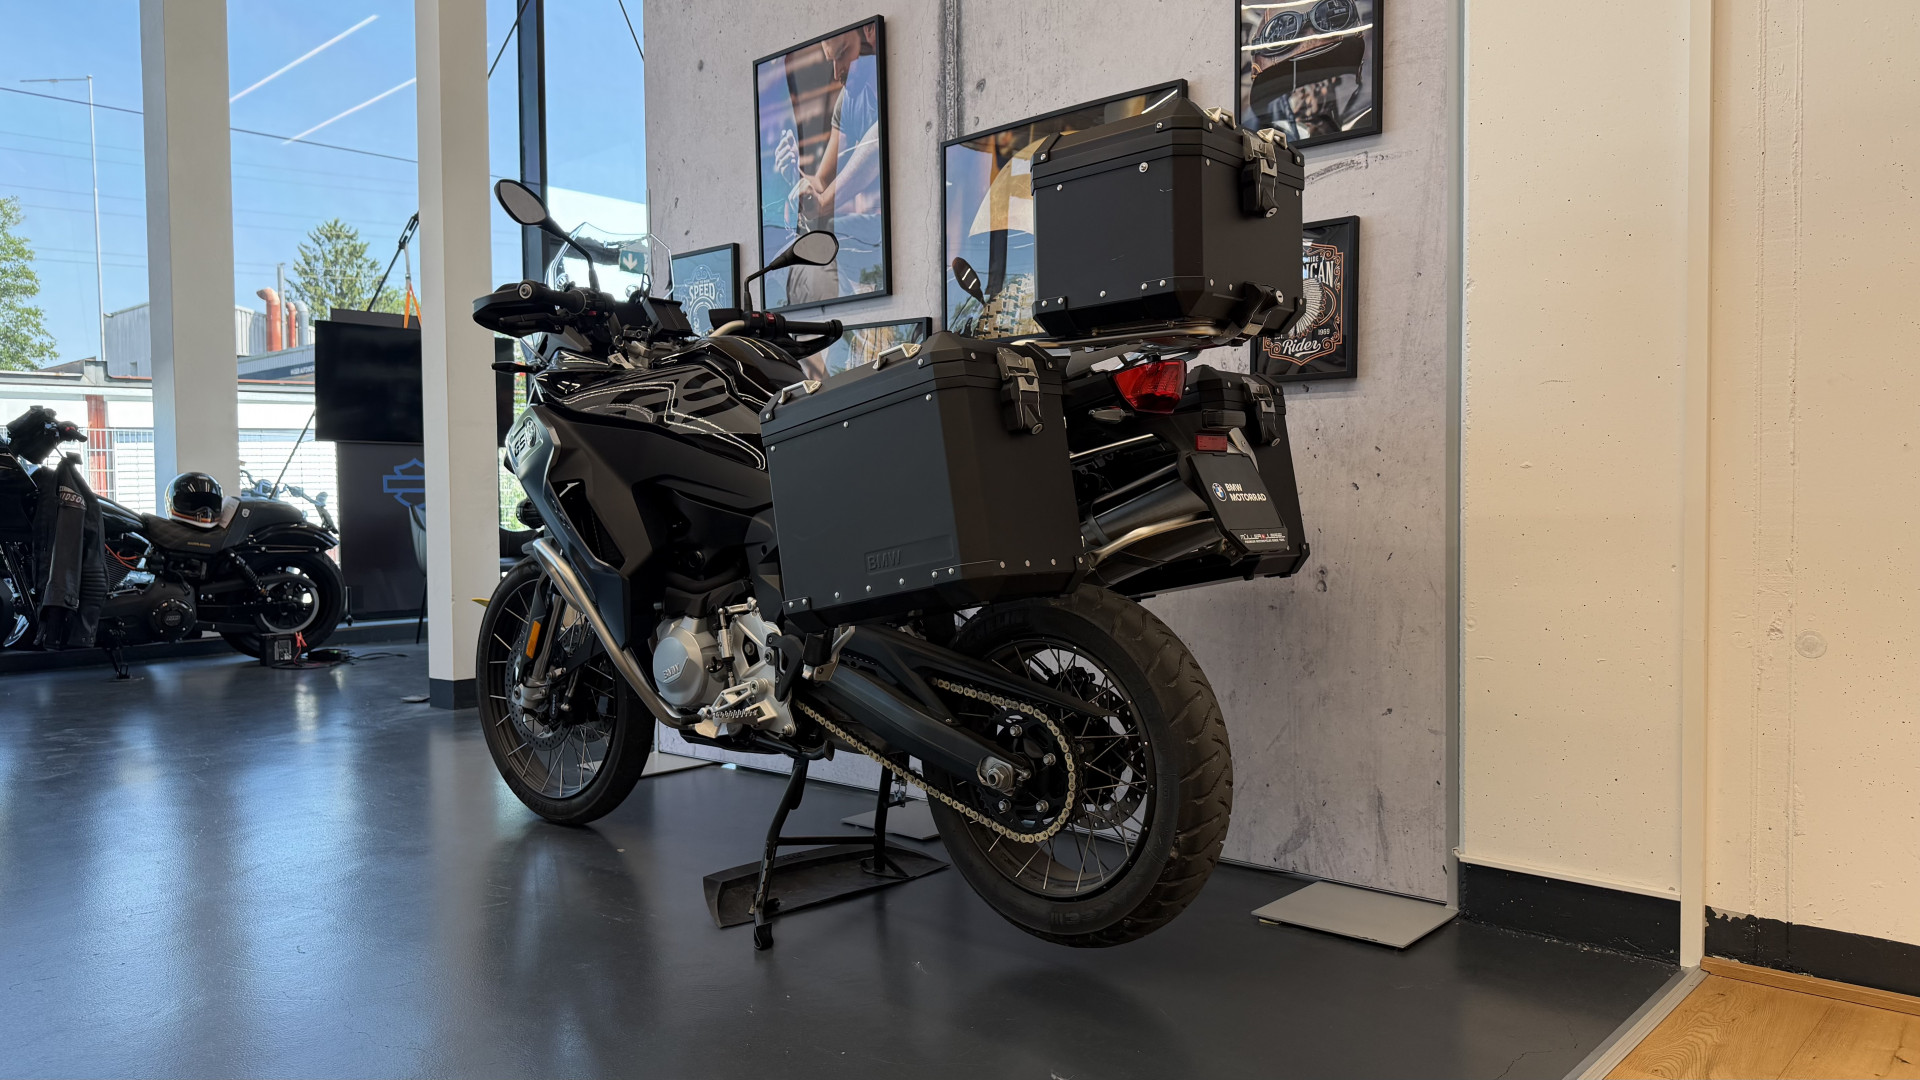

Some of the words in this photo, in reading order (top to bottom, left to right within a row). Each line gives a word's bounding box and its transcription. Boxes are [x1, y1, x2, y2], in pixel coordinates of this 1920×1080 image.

[689, 282, 716, 306] SPEED
[1282, 338, 1321, 357] Rider
[1224, 483, 1243, 492] BMW
[1229, 492, 1267, 502] MOTORRAD
[867, 548, 902, 571] BMW
